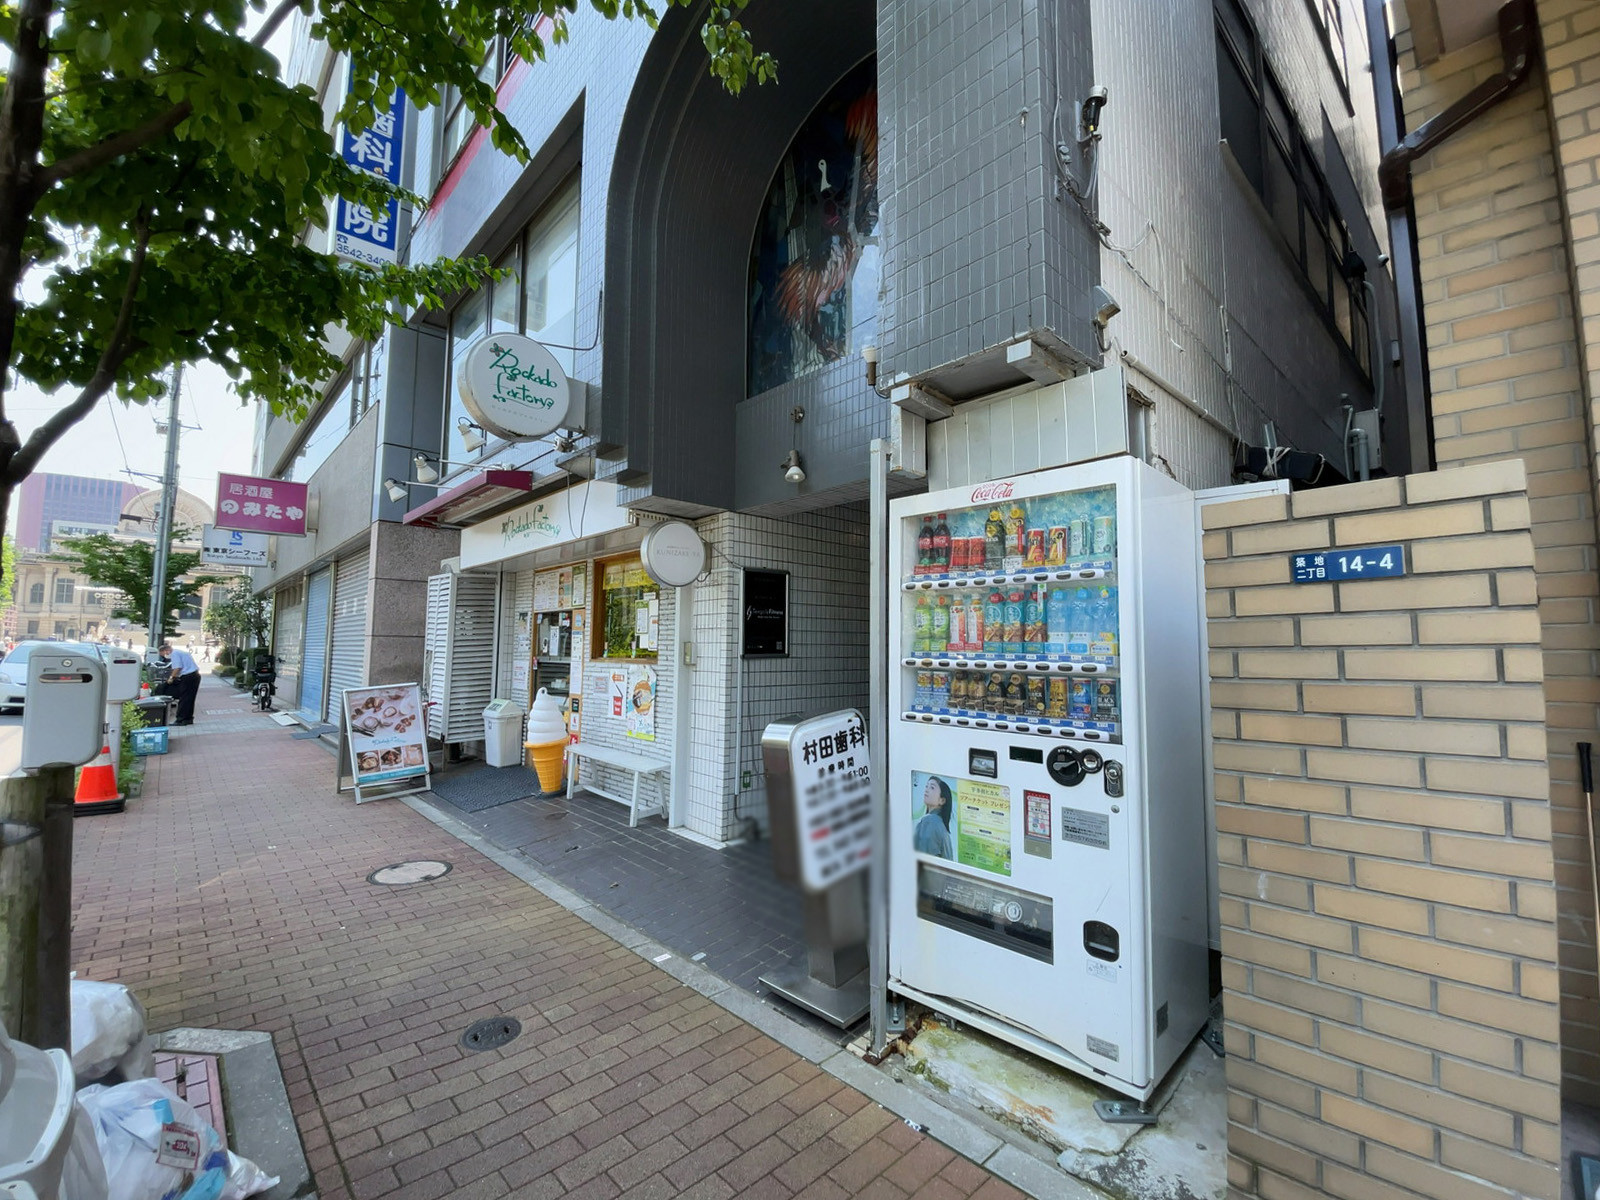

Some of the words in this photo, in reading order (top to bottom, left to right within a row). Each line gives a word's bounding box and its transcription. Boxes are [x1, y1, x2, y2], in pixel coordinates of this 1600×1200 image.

[495, 371, 556, 411] Factory
[229, 482, 275, 499] 居酒屋
[971, 482, 1016, 503] Coca-Cola
[220, 499, 304, 521] のみたや
[1295, 555, 1325, 568] 築地
[1338, 553, 1394, 573] 14-4
[1297, 567, 1326, 579] 二丁目
[802, 726, 866, 765] 村田歯科
